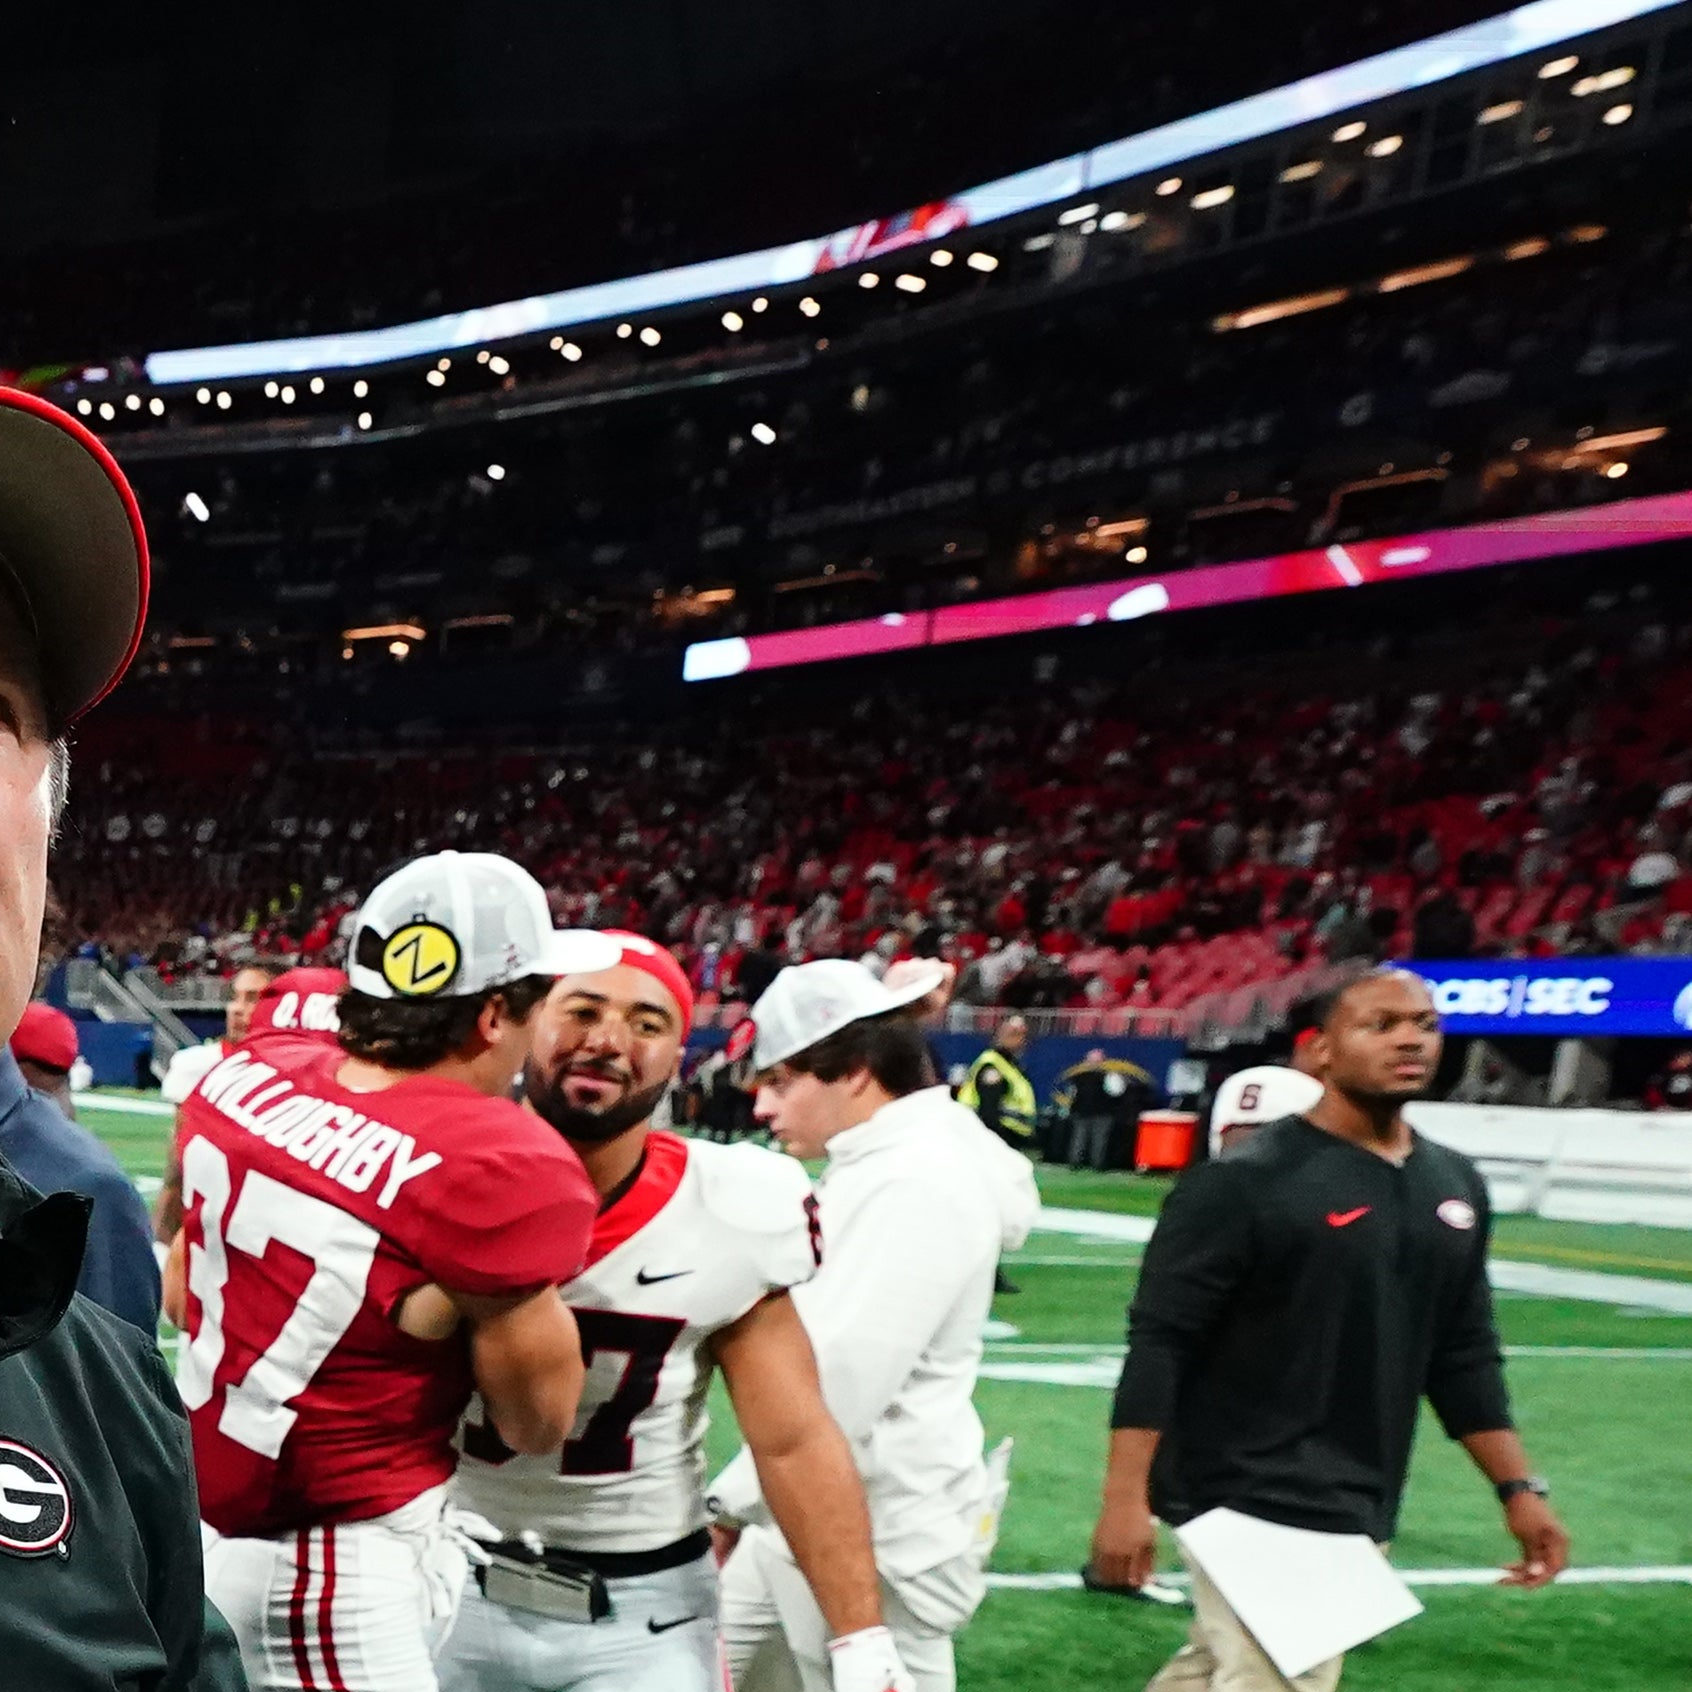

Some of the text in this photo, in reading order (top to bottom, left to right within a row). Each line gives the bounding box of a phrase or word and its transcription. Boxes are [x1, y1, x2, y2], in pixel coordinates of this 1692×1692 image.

[1525, 976, 1614, 1016] SEC
[199, 1050, 444, 1210] WILLOUGHBY
[182, 1133, 379, 1460] 37
